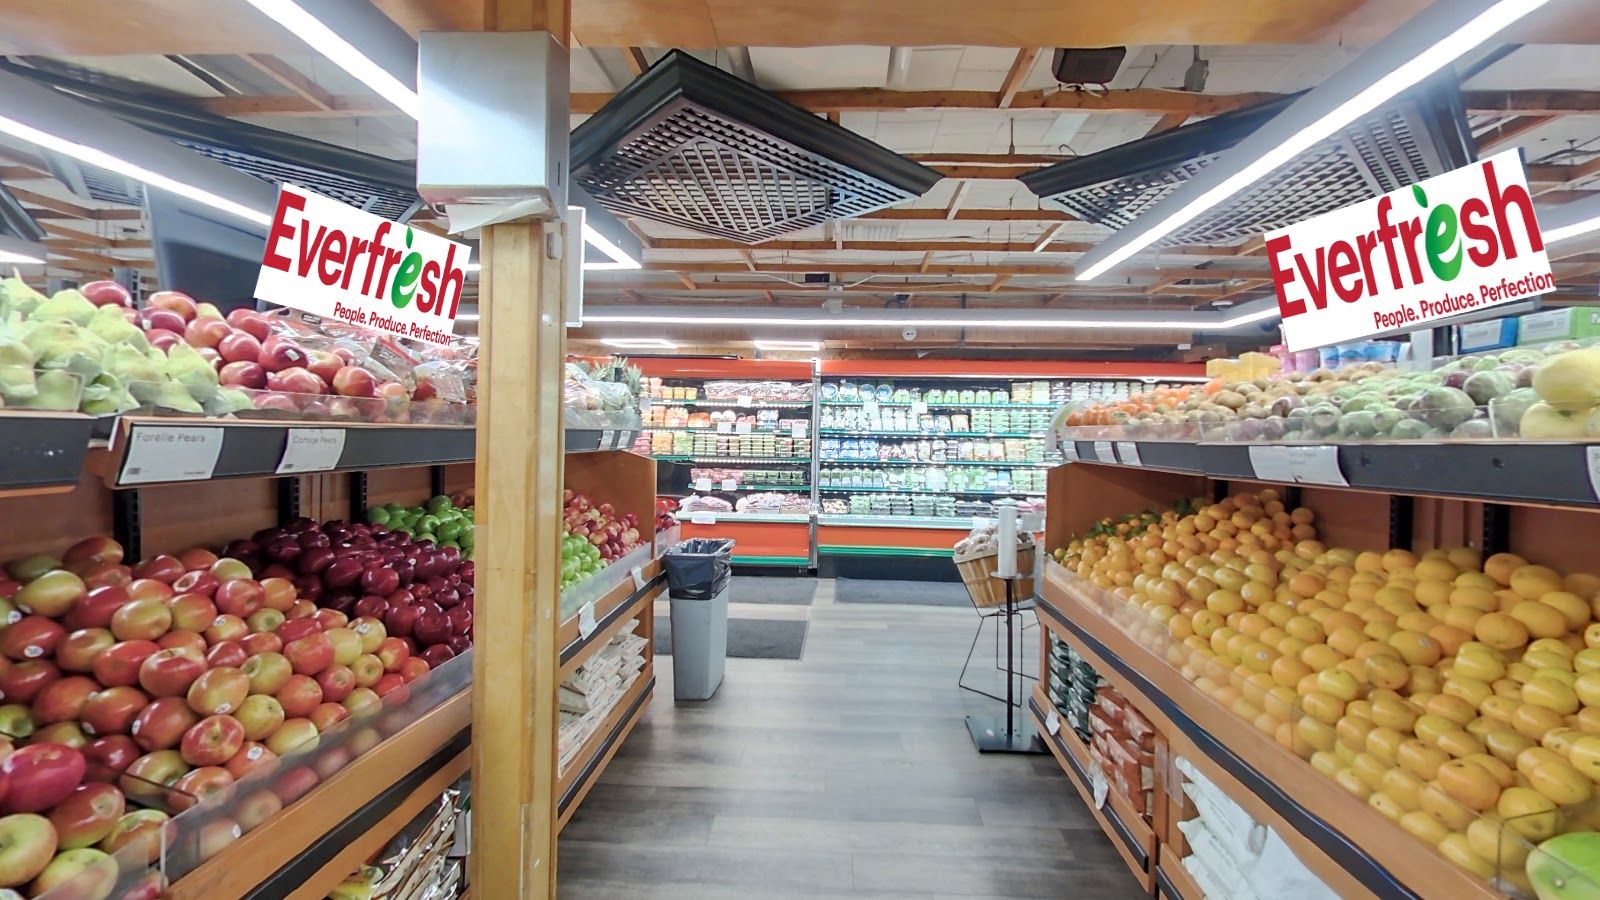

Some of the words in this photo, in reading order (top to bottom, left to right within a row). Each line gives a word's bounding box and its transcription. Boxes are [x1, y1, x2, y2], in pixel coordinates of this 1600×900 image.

[1374, 303, 1420, 330] People.
[1419, 292, 1480, 319] Produce.
[1480, 271, 1556, 304] Perfection
[333, 301, 367, 326] People.
[369, 311, 408, 336] Produce.
[409, 322, 452, 347] Perfection
[136, 432, 175, 442] Forelle
[177, 432, 206, 443] Pears
